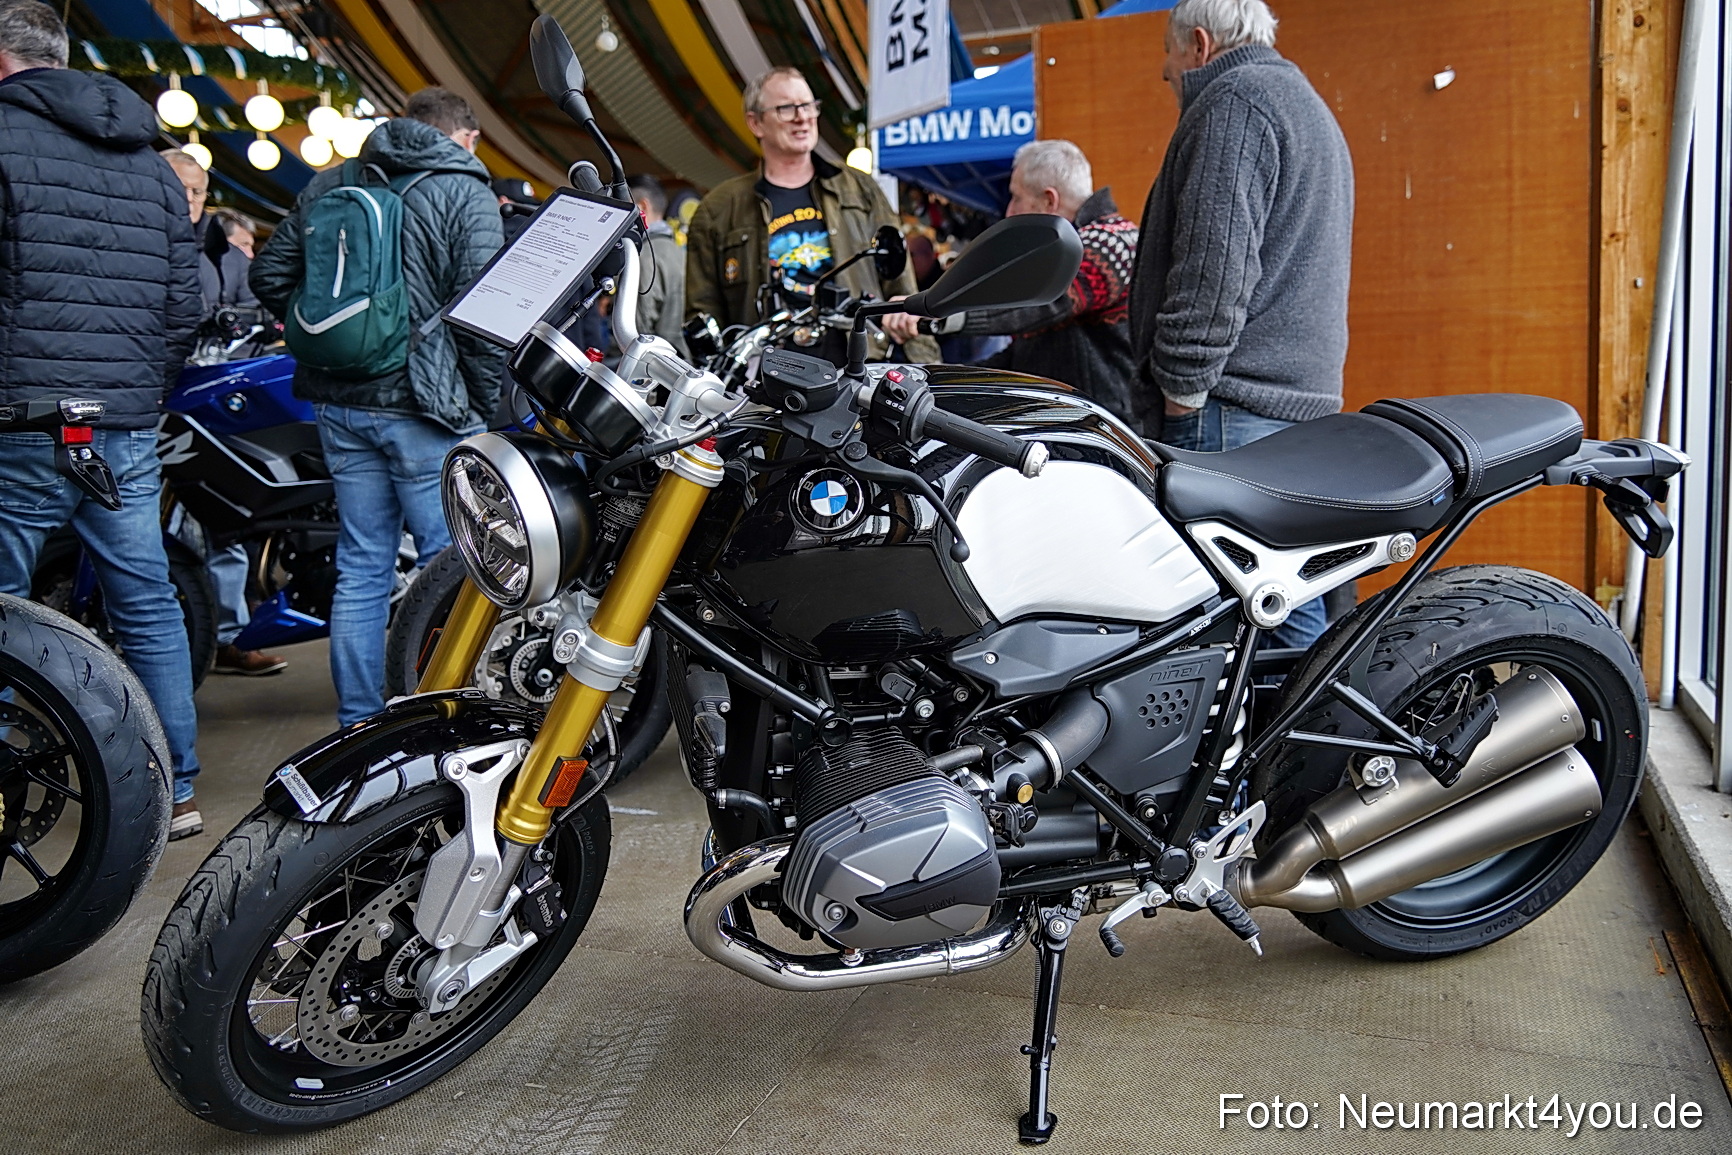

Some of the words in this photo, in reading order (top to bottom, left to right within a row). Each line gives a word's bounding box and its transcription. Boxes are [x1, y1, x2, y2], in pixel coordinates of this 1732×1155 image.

[884, 108, 974, 147] BMW
[978, 104, 1036, 139] Mo
[803, 471, 854, 492] BMW
[536, 891, 554, 928] brembo
[243, 1094, 313, 1121] MICHELIN
